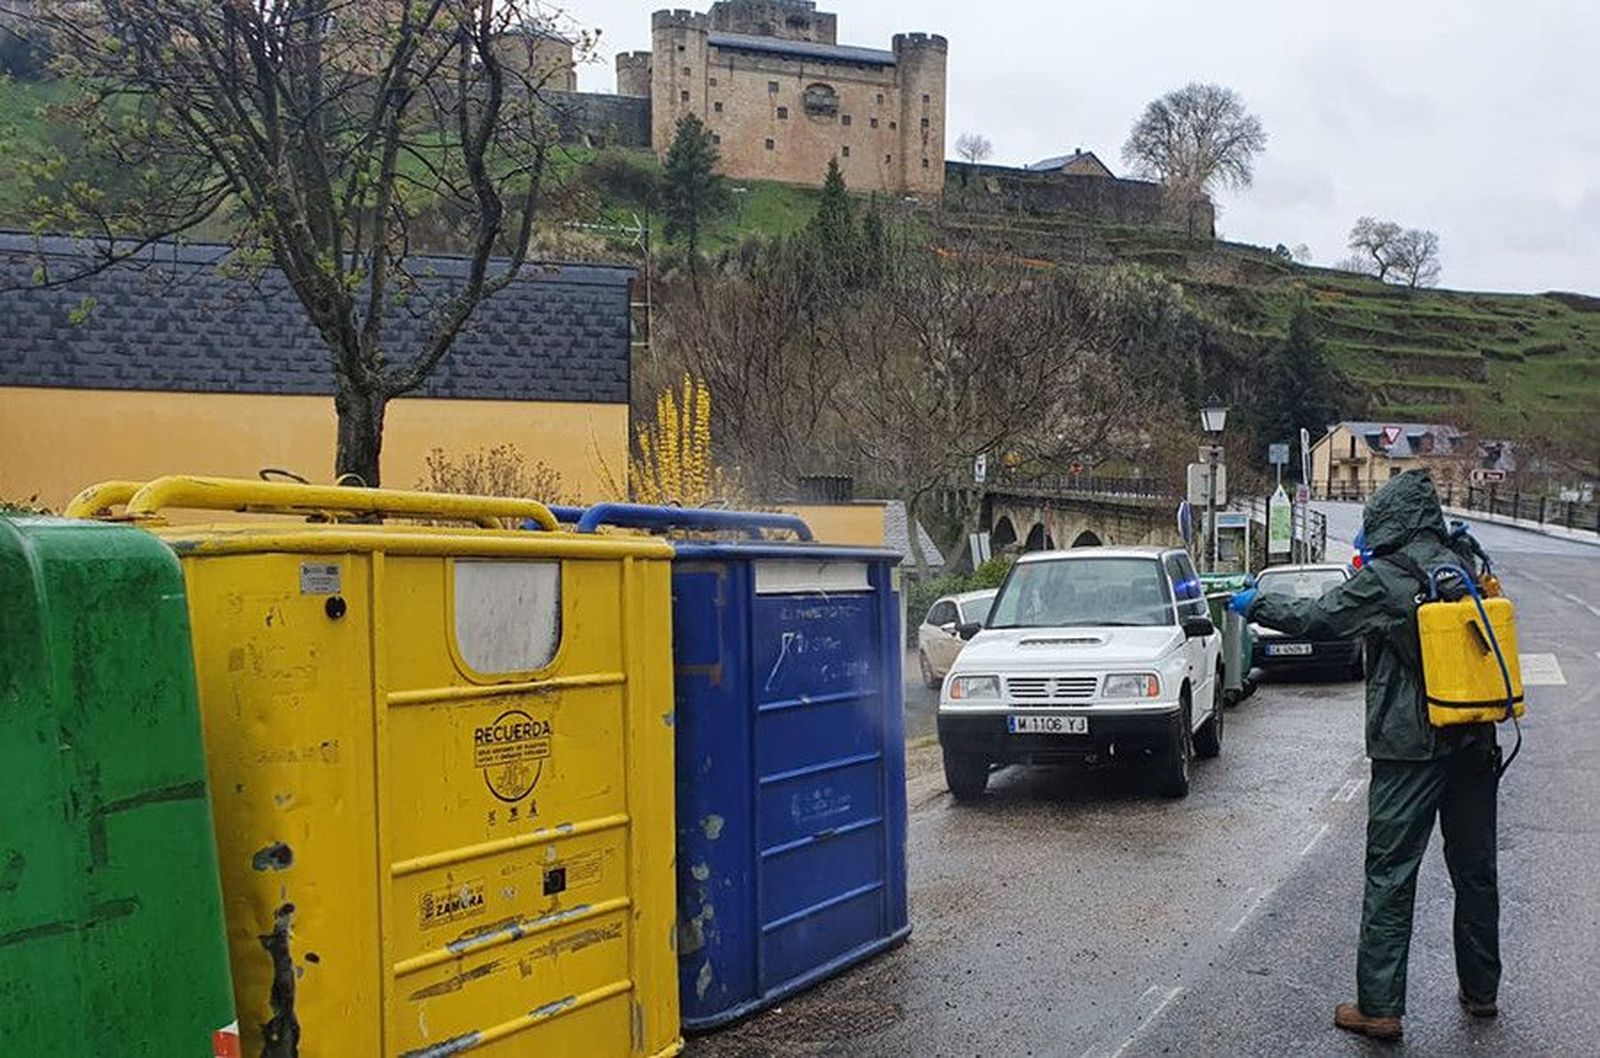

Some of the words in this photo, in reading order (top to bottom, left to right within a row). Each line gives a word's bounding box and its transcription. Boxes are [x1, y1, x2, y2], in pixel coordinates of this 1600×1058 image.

[474, 720, 551, 744] RECUERDA
[1032, 717, 1062, 732] 1106
[1067, 717, 1086, 732] YJ
